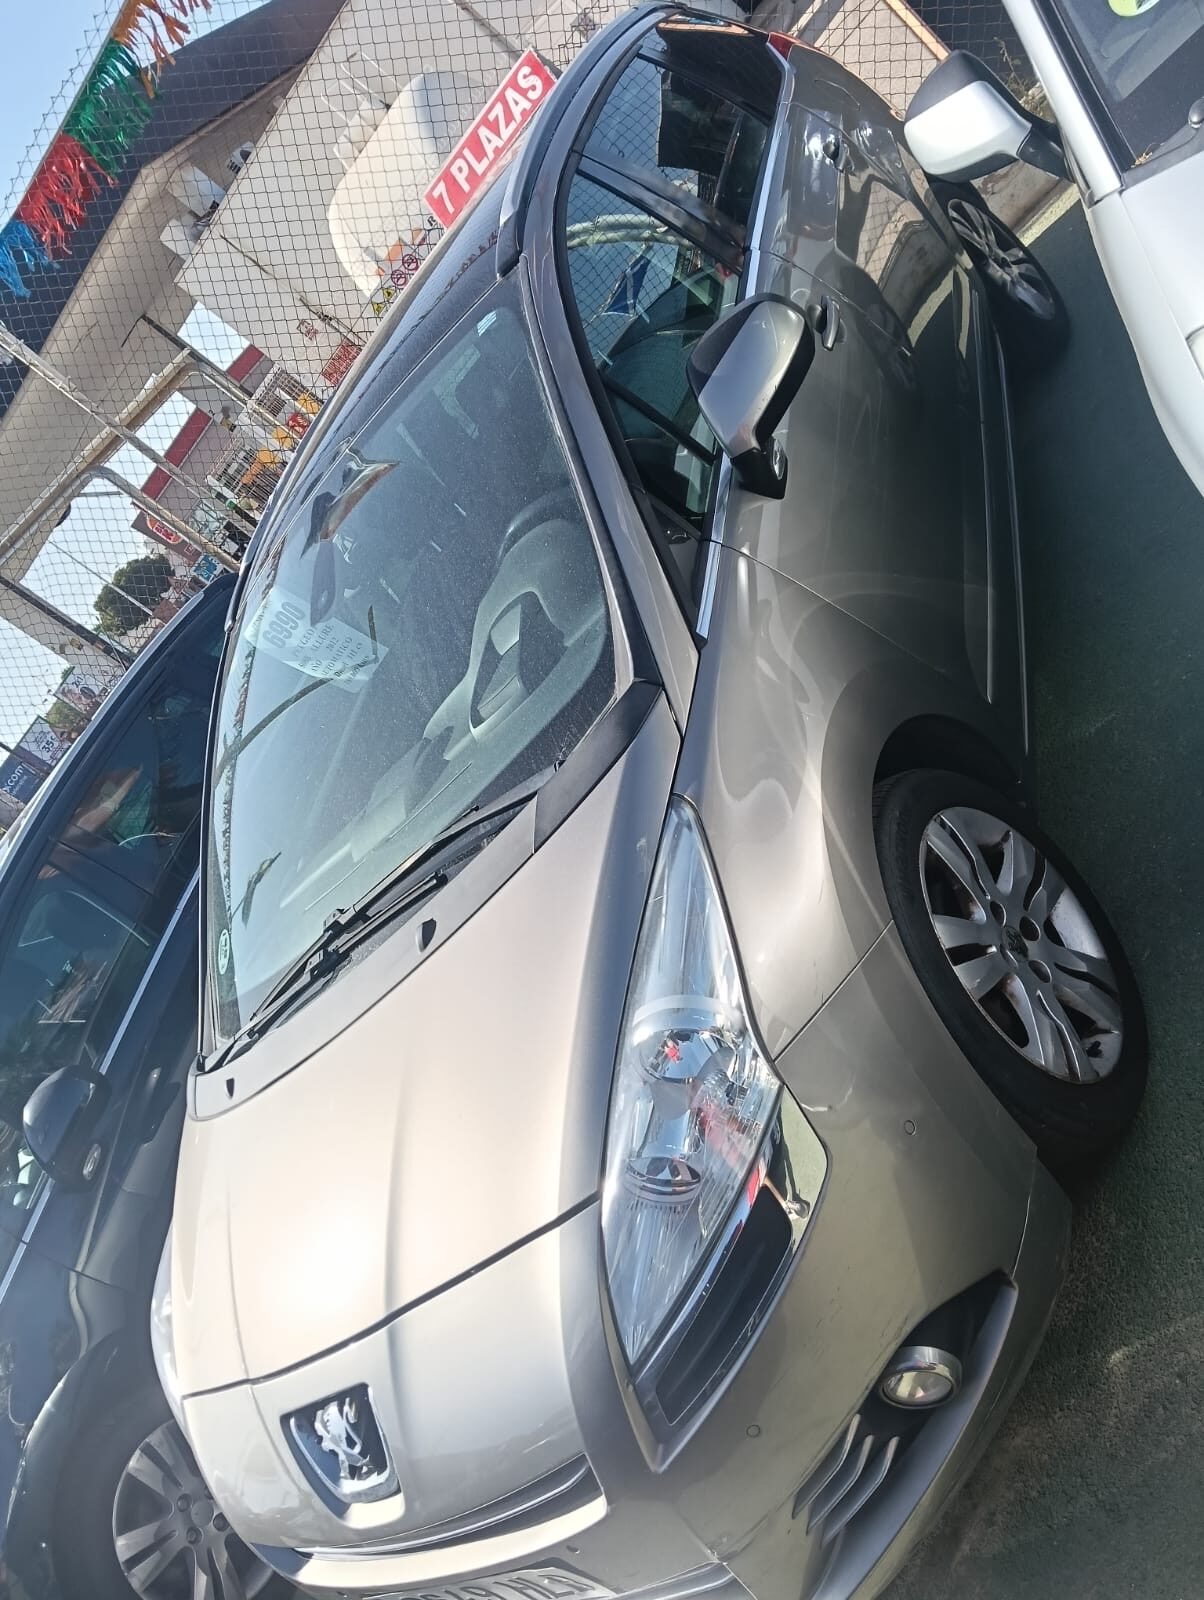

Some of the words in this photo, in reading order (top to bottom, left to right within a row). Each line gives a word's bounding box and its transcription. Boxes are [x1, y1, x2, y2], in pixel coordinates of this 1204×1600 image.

[432, 178, 455, 214] 7
[450, 66, 543, 192] PLAZAS
[262, 602, 306, 649] 6990
[320, 637, 352, 676] UTOMATICO
